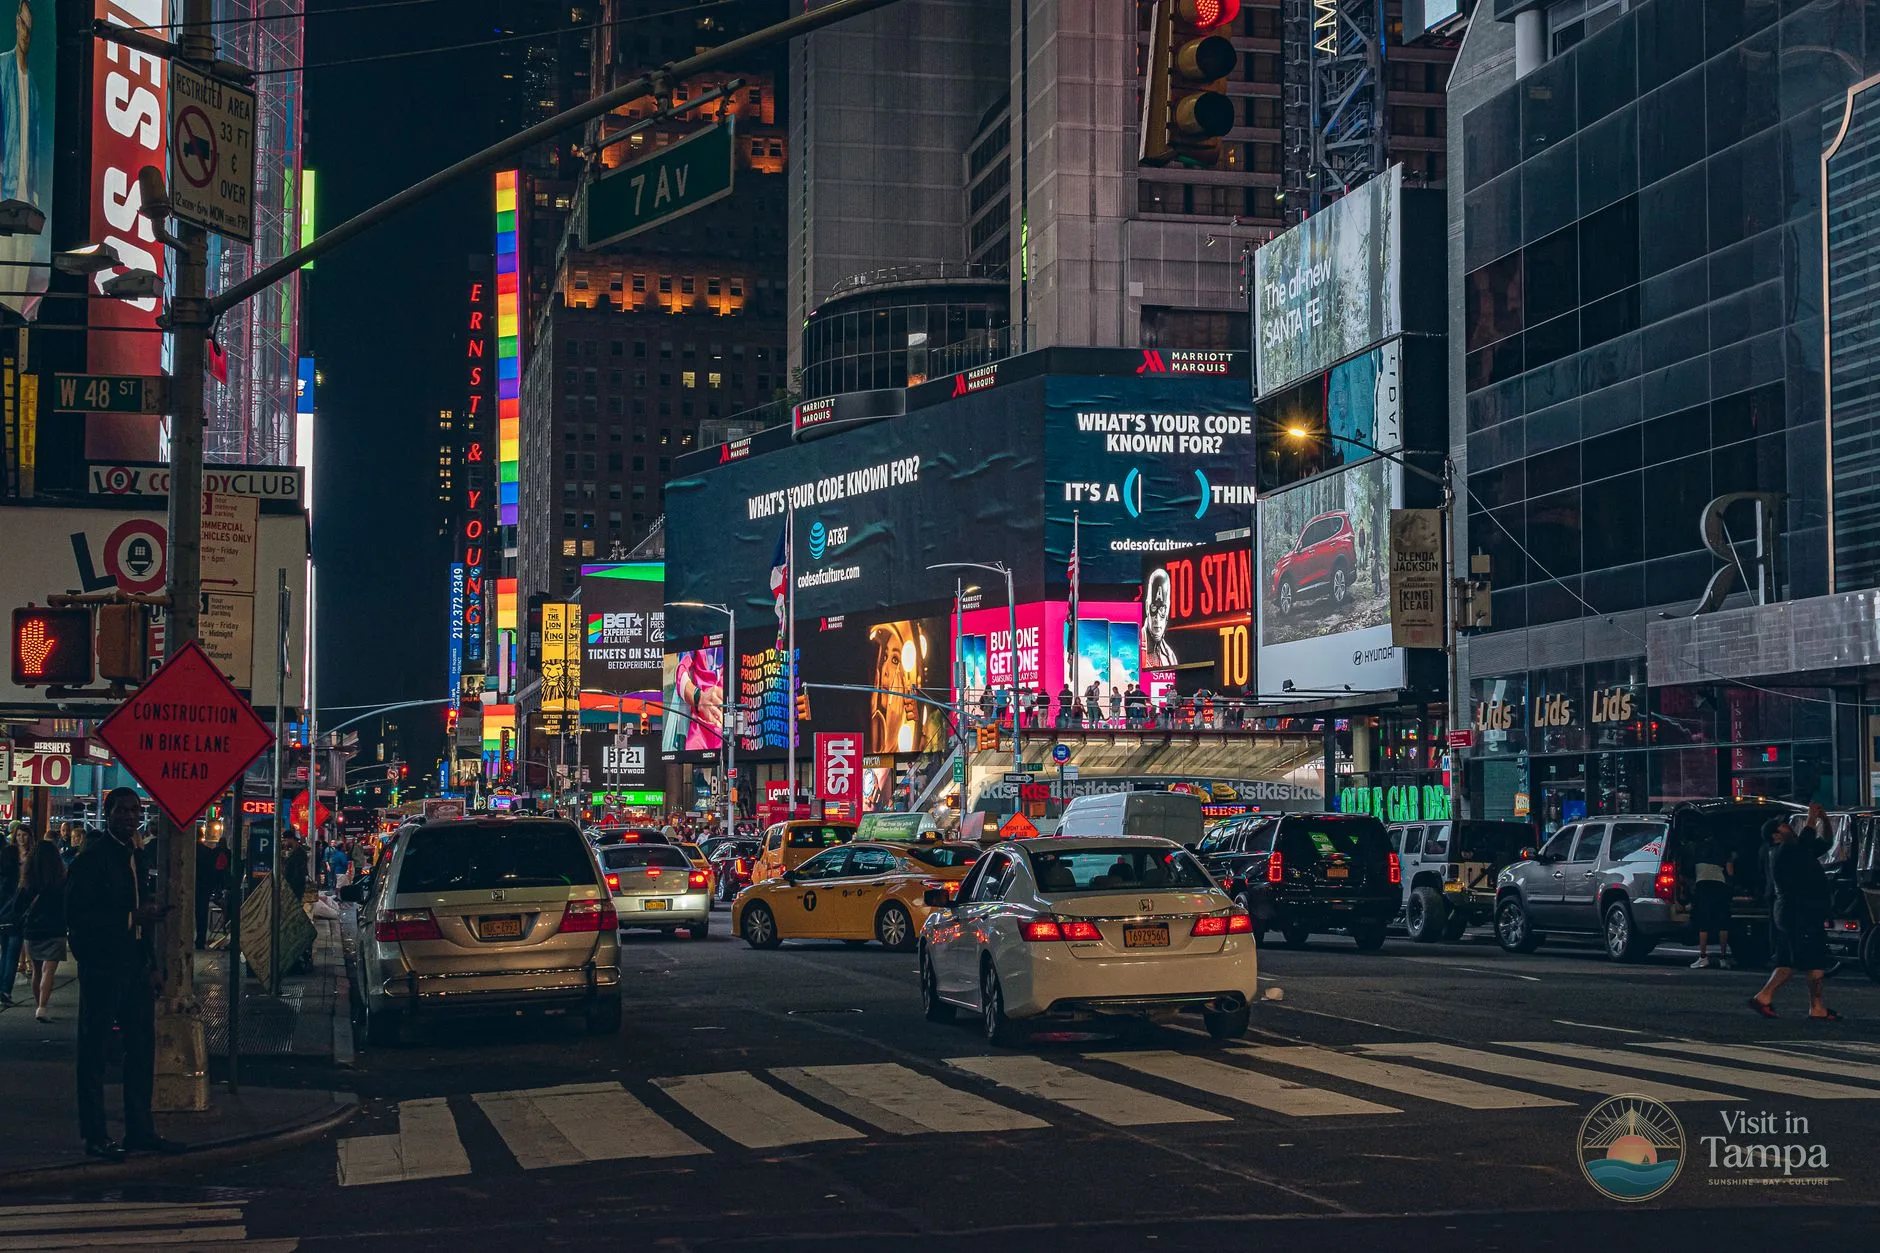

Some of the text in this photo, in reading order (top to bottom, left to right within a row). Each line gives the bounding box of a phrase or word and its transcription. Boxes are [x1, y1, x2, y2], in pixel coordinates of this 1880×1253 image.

[176, 73, 250, 121] RESTRICTED AREA
[220, 121, 249, 149] 33 FT
[220, 180, 246, 206] OVER
[630, 164, 689, 216] 7 AV
[209, 204, 224, 222] MON
[1264, 256, 1332, 311] The all-new
[1266, 297, 1323, 349] SANTA FE
[468, 284, 484, 414] ERNST
[1172, 352, 1234, 362] MARRIOTT
[968, 364, 998, 380] MARRIOTT
[1172, 362, 1226, 372] MARQUIS
[968, 376, 994, 390] MARQUIS
[60, 379, 136, 408] W 48 ST
[802, 398, 836, 414] MARRIOTT
[802, 410, 830, 424] MARQUIS
[1077, 412, 1252, 434] WHAT'S YOUR CODE
[467, 442, 484, 462] &
[730, 438, 752, 450] MARRIOTT
[730, 446, 750, 459] MARQUIS
[1106, 434, 1223, 454] KNOWN FOR?
[748, 455, 920, 520] WHAT'S YOUR CODE KNOWN FOR?
[1065, 483, 1101, 502] IT'S
[1105, 484, 1120, 502] A
[202, 520, 244, 532] MMERCIAL
[202, 532, 252, 544] HICLES ONLY
[827, 526, 848, 547] AT&T
[465, 490, 484, 625] YOUNG
[1397, 552, 1435, 562] GLENDA
[1394, 562, 1438, 572] JACKSON
[798, 565, 860, 589] codesofculture.com
[1166, 560, 1194, 619] TO
[452, 568, 464, 639] 212.372.2349
[220, 621, 239, 630] Friday
[546, 621, 561, 631] LION
[604, 612, 636, 628] BET
[209, 630, 233, 640] Midnight
[544, 630, 564, 642] KING
[604, 628, 642, 636] EXPERIENCE
[990, 626, 1039, 652] BUY ONE
[588, 649, 627, 660] TICKETS
[629, 648, 641, 659] ON
[742, 652, 764, 668] PROUD
[1219, 624, 1248, 686] TO
[1364, 646, 1395, 663] HYUNDAI
[990, 652, 1012, 675] GET
[740, 668, 762, 681] PROUD
[992, 674, 1012, 683] SAMSUNG
[1018, 673, 1030, 681] LAXY
[742, 682, 764, 695] PROUD
[134, 702, 238, 725] CONSTRUCTION
[1534, 693, 1570, 728] Lids
[1592, 688, 1632, 723] Lids
[1478, 700, 1512, 732] Lids
[743, 723, 762, 737] OUD
[34, 742, 70, 753] HERSHEY'S
[140, 733, 232, 754] IN BIKE LANE
[742, 738, 764, 751] PROUD
[161, 761, 209, 780] AHEAD
[828, 738, 856, 795] tkts
[1020, 782, 1050, 800] kts
[1200, 806, 1246, 815] HEESE
